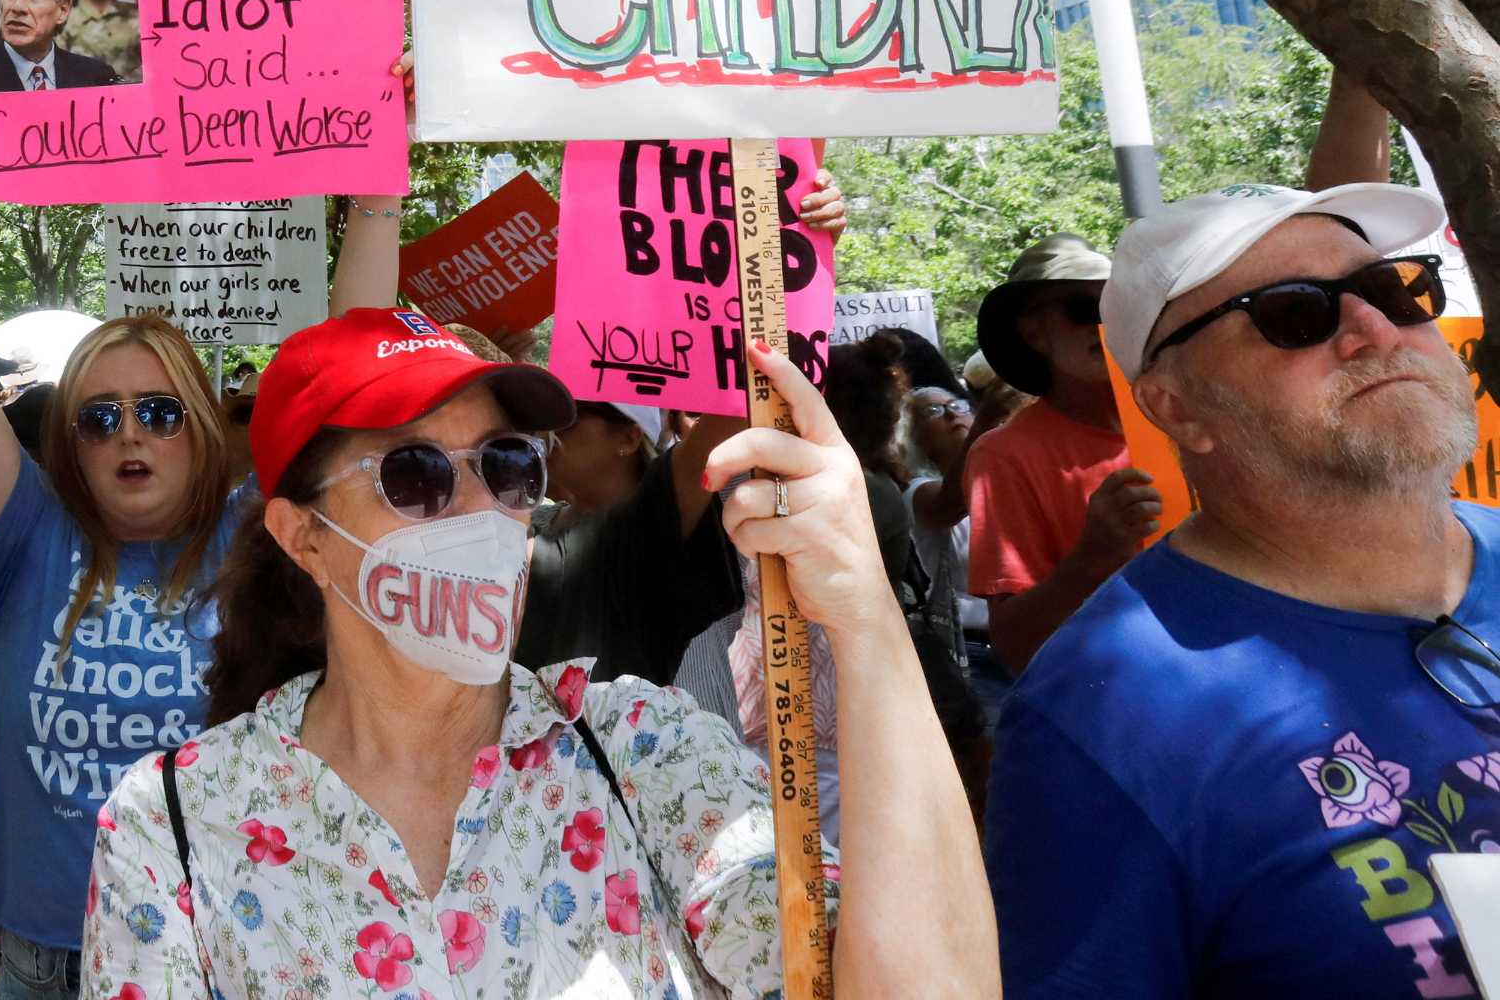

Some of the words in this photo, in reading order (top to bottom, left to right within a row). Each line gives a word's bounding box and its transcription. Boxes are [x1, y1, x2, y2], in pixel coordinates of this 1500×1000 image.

[179, 96, 260, 156] been
[618, 140, 800, 226] THER
[741, 186, 757, 240] 6102
[759, 196, 770, 213] 15
[189, 220, 229, 237] our
[234, 216, 316, 242] children
[118, 238, 187, 262] freeze
[197, 243, 216, 262] to
[223, 241, 272, 263] death
[407, 268, 448, 298] WE
[438, 243, 492, 286] CAN
[484, 211, 541, 259] END
[620, 210, 817, 292] BLOD
[762, 240, 773, 259] 16
[180, 277, 211, 293] our
[218, 271, 259, 300] girls
[267, 278, 302, 294] are
[765, 284, 776, 302] 17
[182, 298, 214, 320] and
[218, 299, 282, 321] denied
[422, 288, 469, 323] GUN
[834, 296, 926, 316] ASSAULT
[745, 252, 770, 401] WESTHEER
[768, 328, 779, 347] 18
[828, 322, 908, 343] EAPO
[577, 320, 693, 391] YOUR
[366, 562, 509, 655] GUNS
[786, 601, 798, 620] 24
[768, 613, 788, 668] (713)
[33, 641, 212, 698] Knock
[790, 647, 802, 668] 25
[793, 694, 804, 713] 26
[774, 679, 796, 801] 785-6400
[796, 741, 808, 760] 27
[800, 786, 812, 808] 28
[803, 833, 815, 855] 29
[805, 881, 817, 901] 30
[809, 928, 820, 948] 31
